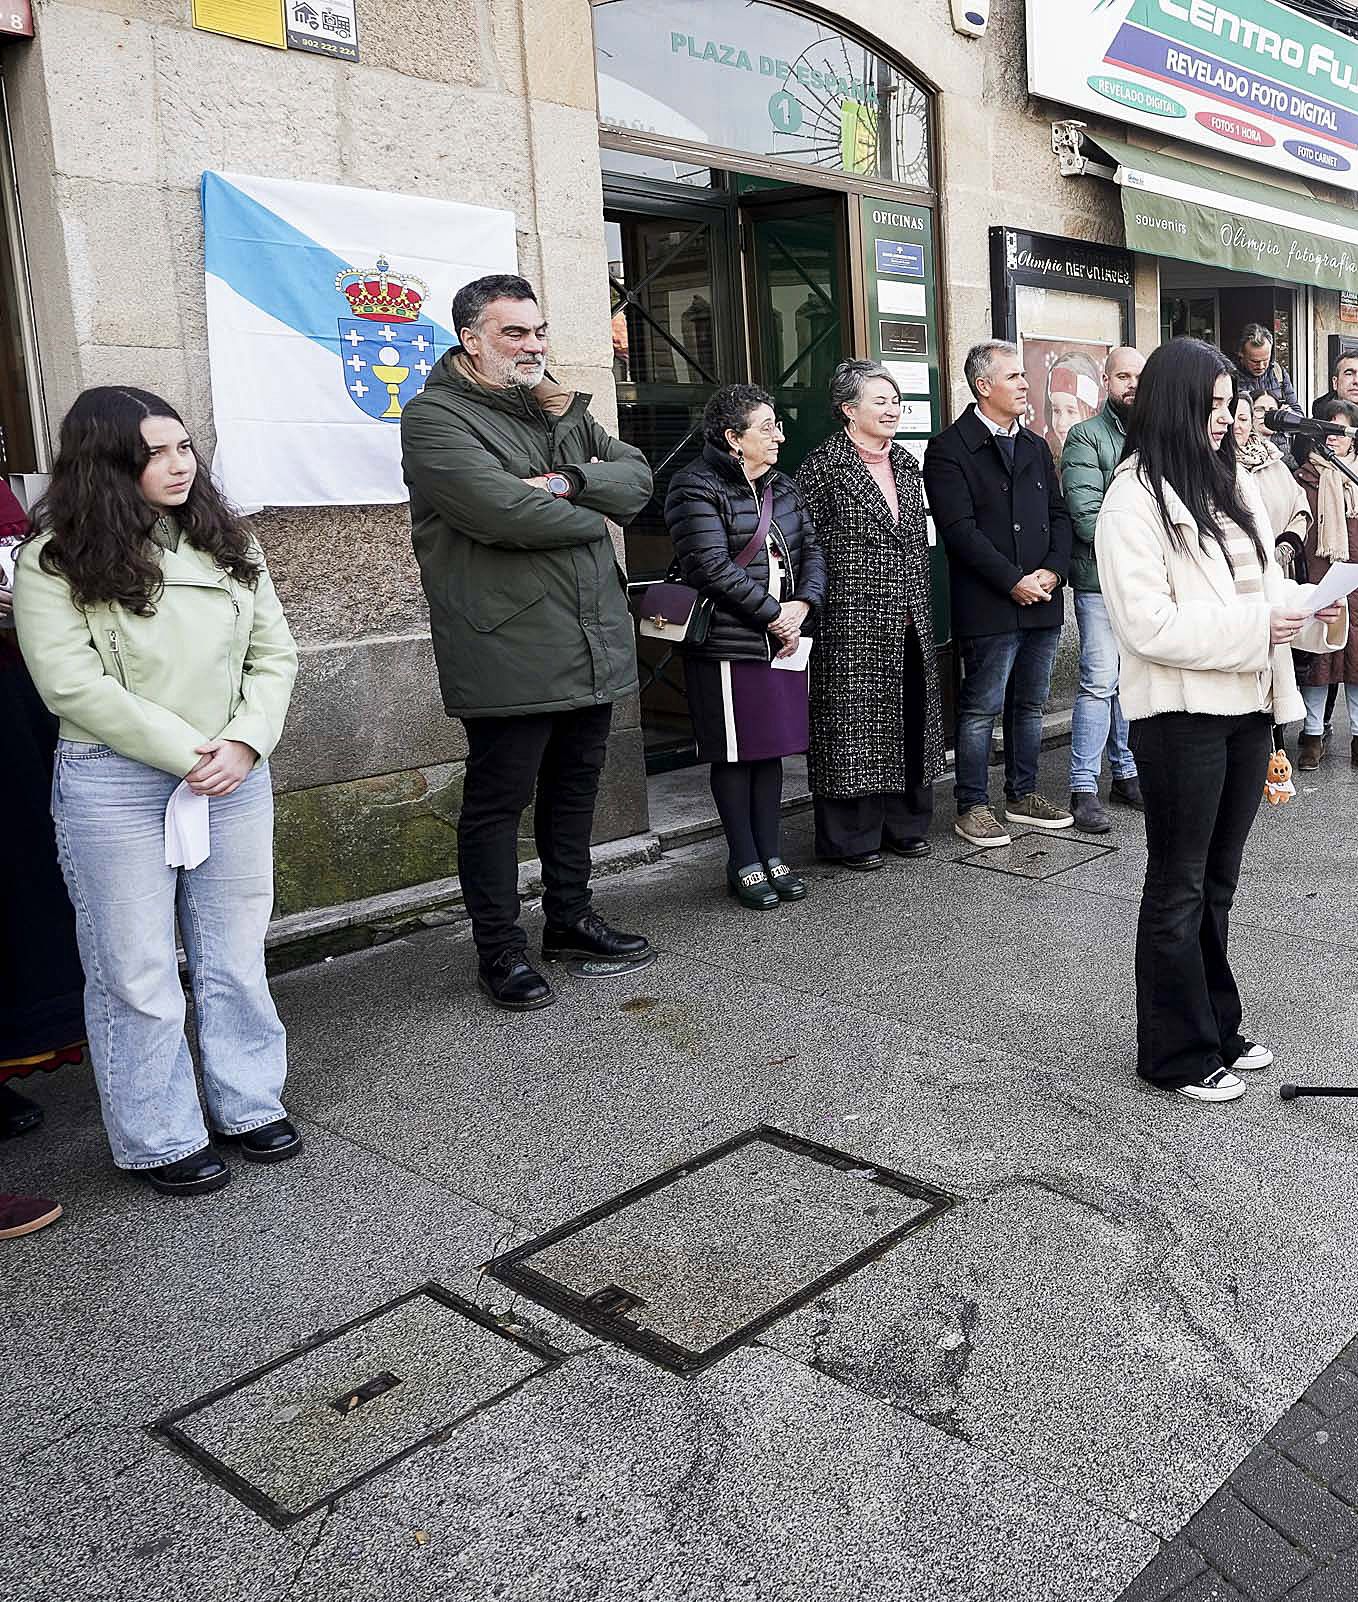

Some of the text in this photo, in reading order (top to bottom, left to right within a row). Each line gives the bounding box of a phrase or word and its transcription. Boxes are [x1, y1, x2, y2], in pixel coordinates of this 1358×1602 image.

[301, 38, 319, 48] 902
[320, 42, 338, 52] 222
[671, 32, 879, 104] PLAZA DE ESPAÑA
[1098, 79, 1177, 114] REVELADO DIGITAL
[1166, 48, 1339, 131] REVELADO FOTO DIGITAL
[776, 98, 790, 126] 1
[1211, 116, 1262, 143] FOTOS 1 HORA
[1297, 145, 1338, 168] FOTO CARNET
[872, 210, 924, 231] OFICINAS
[1135, 214, 1187, 235] souvenirs
[1220, 223, 1280, 261] Olimpio
[1017, 250, 1063, 275] Olimpio
